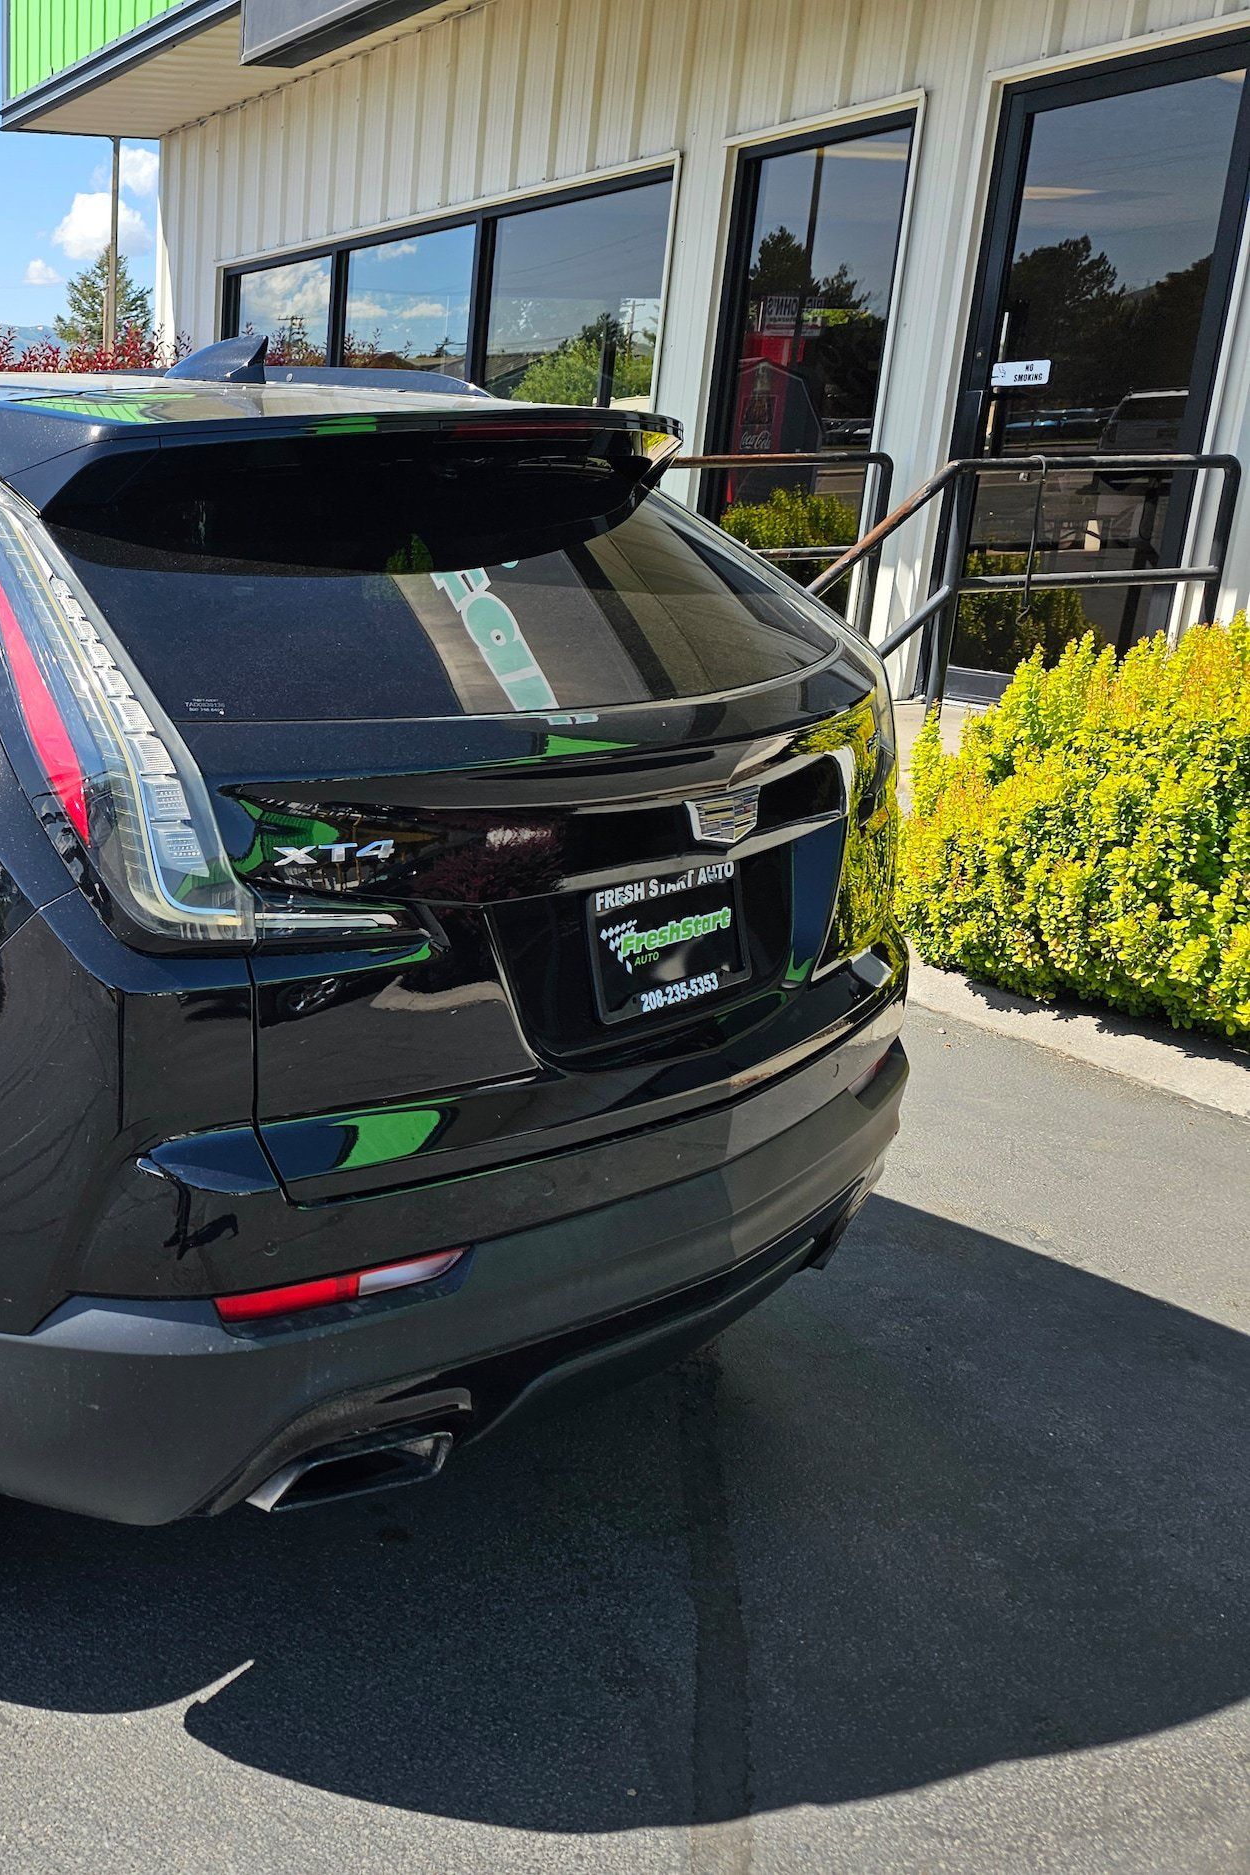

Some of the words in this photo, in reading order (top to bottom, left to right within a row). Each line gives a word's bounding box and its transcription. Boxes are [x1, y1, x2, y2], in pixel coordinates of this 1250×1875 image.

[1013, 373, 1043, 382] SMOKING
[1025, 363, 1034, 371] NO
[273, 839, 395, 867] XT4
[595, 881, 645, 912] FRESH
[697, 860, 735, 886] AUTO
[619, 906, 732, 957] FreshStart
[634, 951, 660, 967] AUTO
[640, 972, 720, 1013] 208-235-5353
